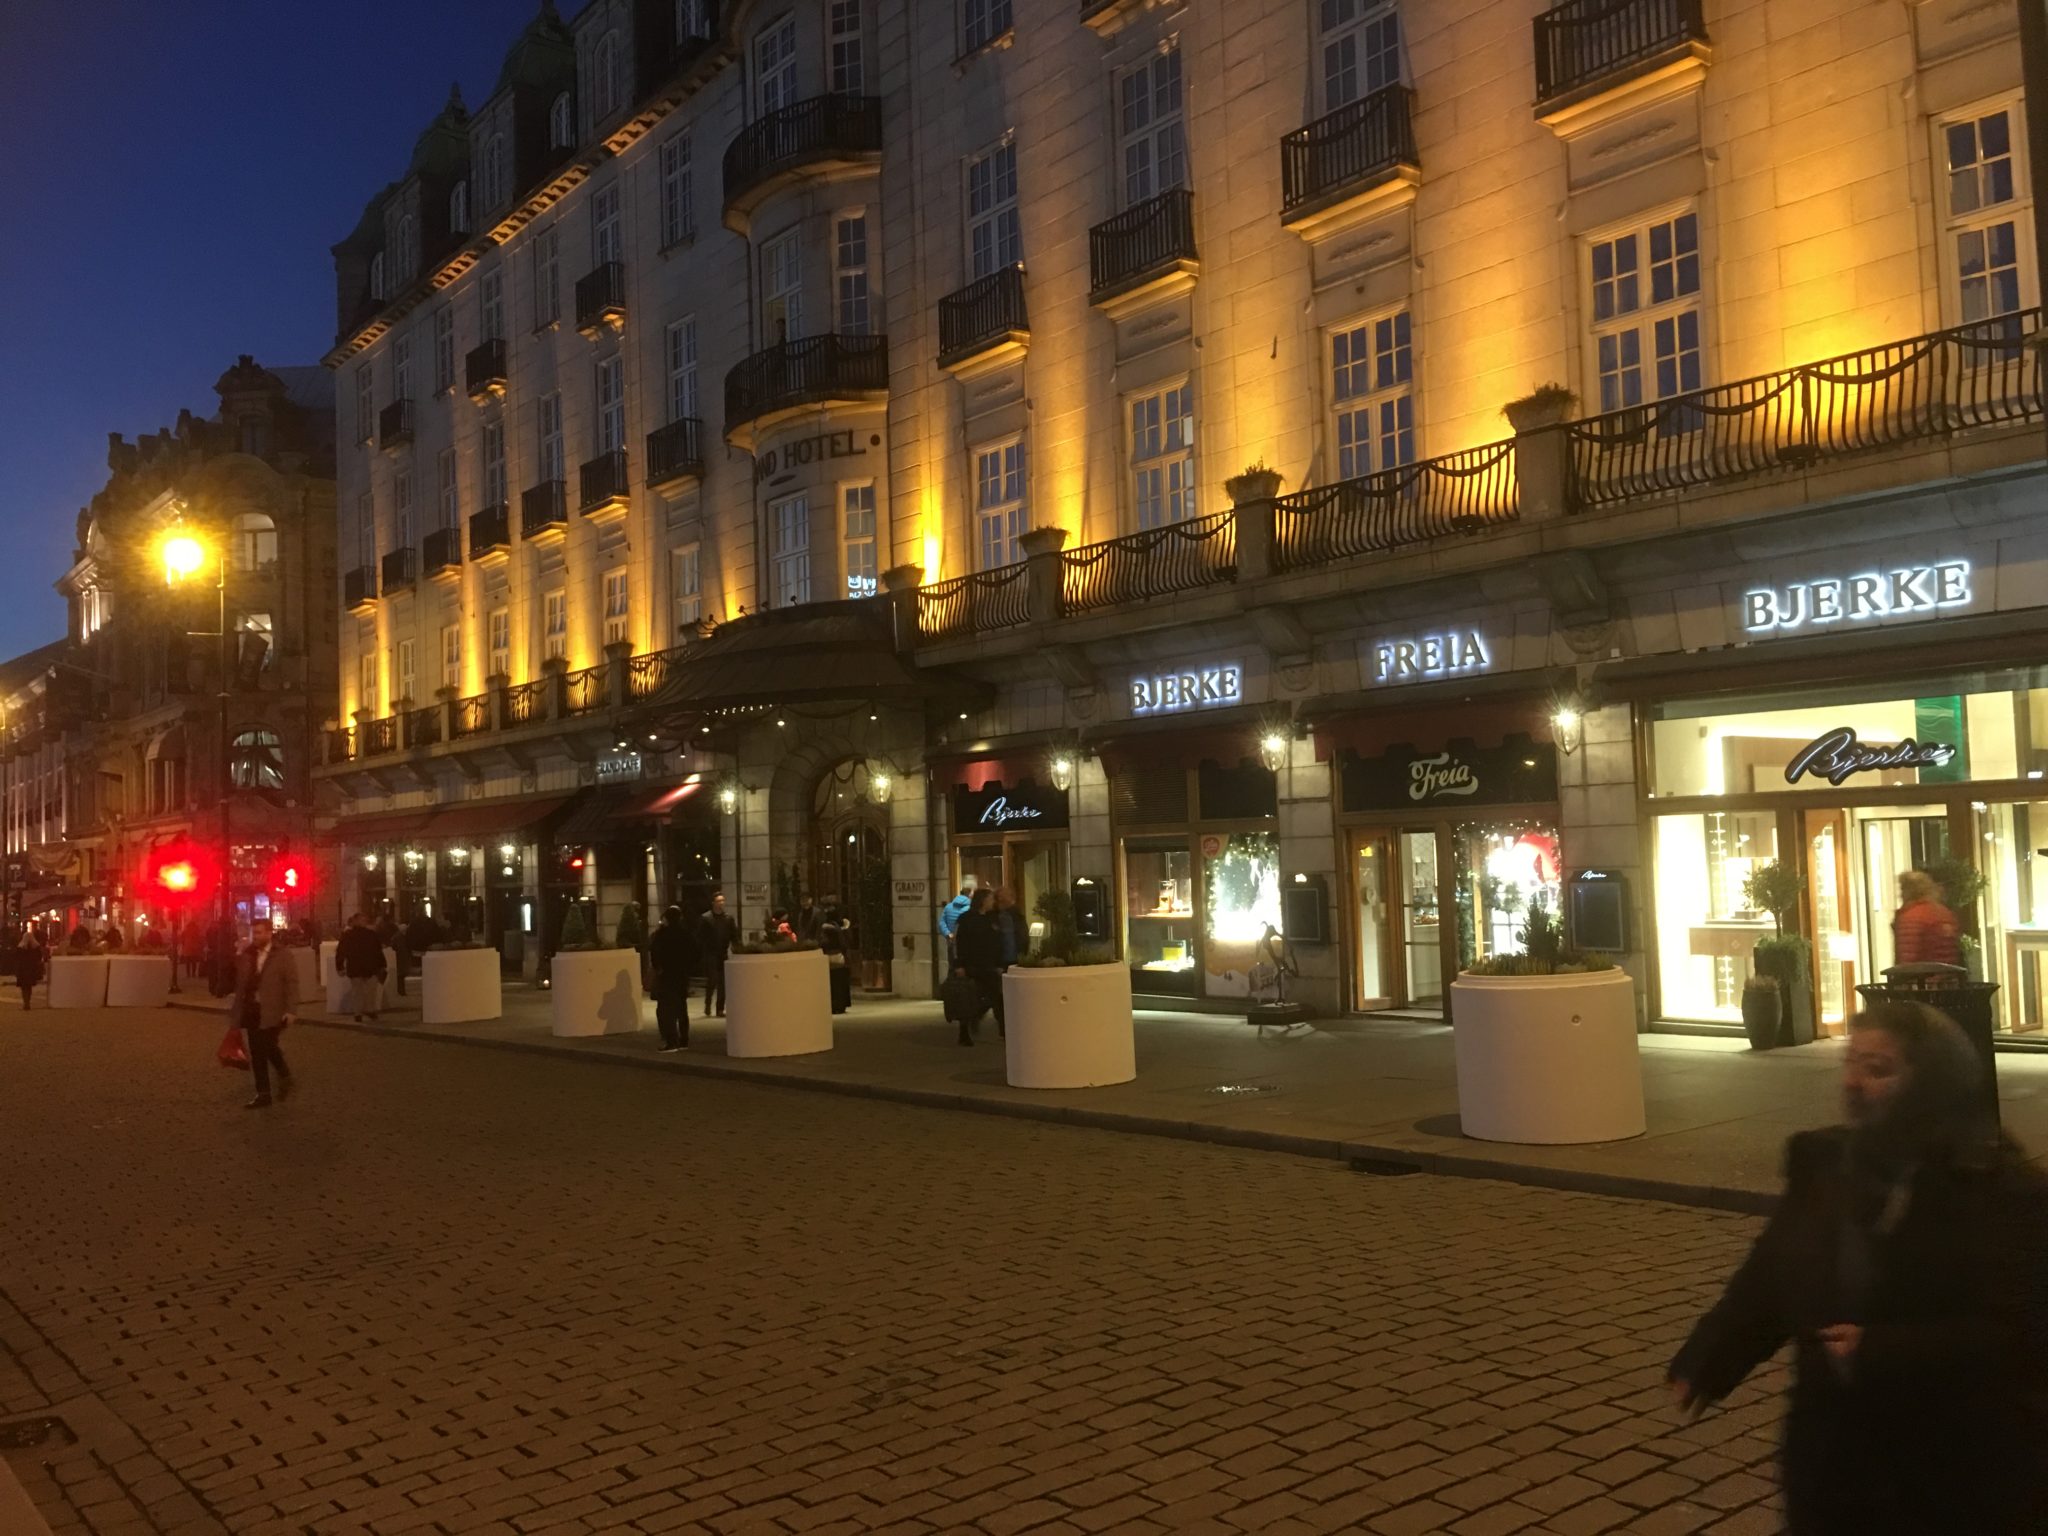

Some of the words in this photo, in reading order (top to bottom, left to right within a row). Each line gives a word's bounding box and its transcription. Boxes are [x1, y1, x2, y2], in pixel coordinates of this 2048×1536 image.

[784, 429, 867, 469] HOTEL
[1745, 562, 1970, 630] BJERKE
[1375, 632, 1488, 679] FREIA
[1131, 668, 1239, 709] BJERKE
[1408, 752, 1479, 800] Freia
[1785, 727, 1956, 786] Bjerke
